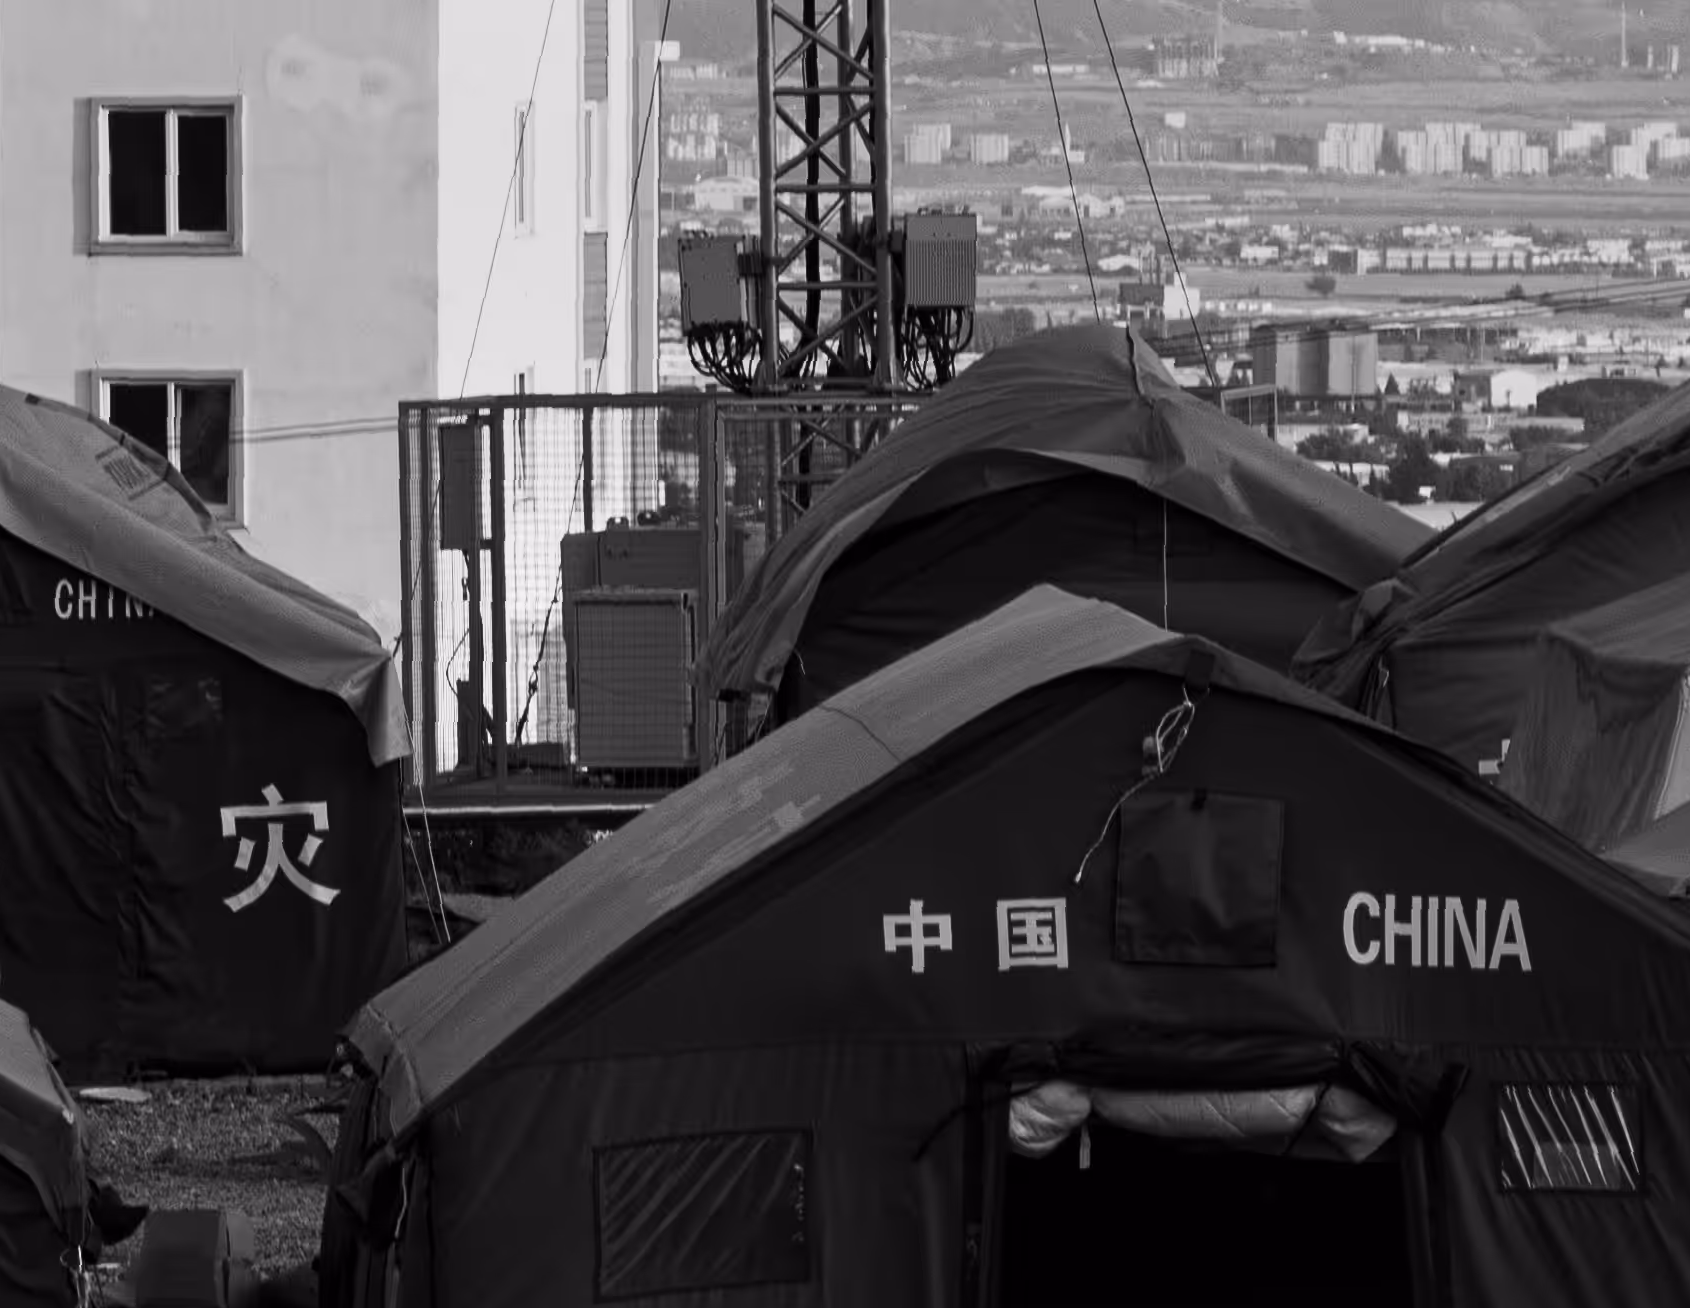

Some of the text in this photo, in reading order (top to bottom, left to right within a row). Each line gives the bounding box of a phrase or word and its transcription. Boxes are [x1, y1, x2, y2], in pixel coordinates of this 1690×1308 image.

[53, 578, 155, 621] CHIN
[219, 783, 341, 913] 灾
[882, 891, 1532, 973] 中国 CHINA
